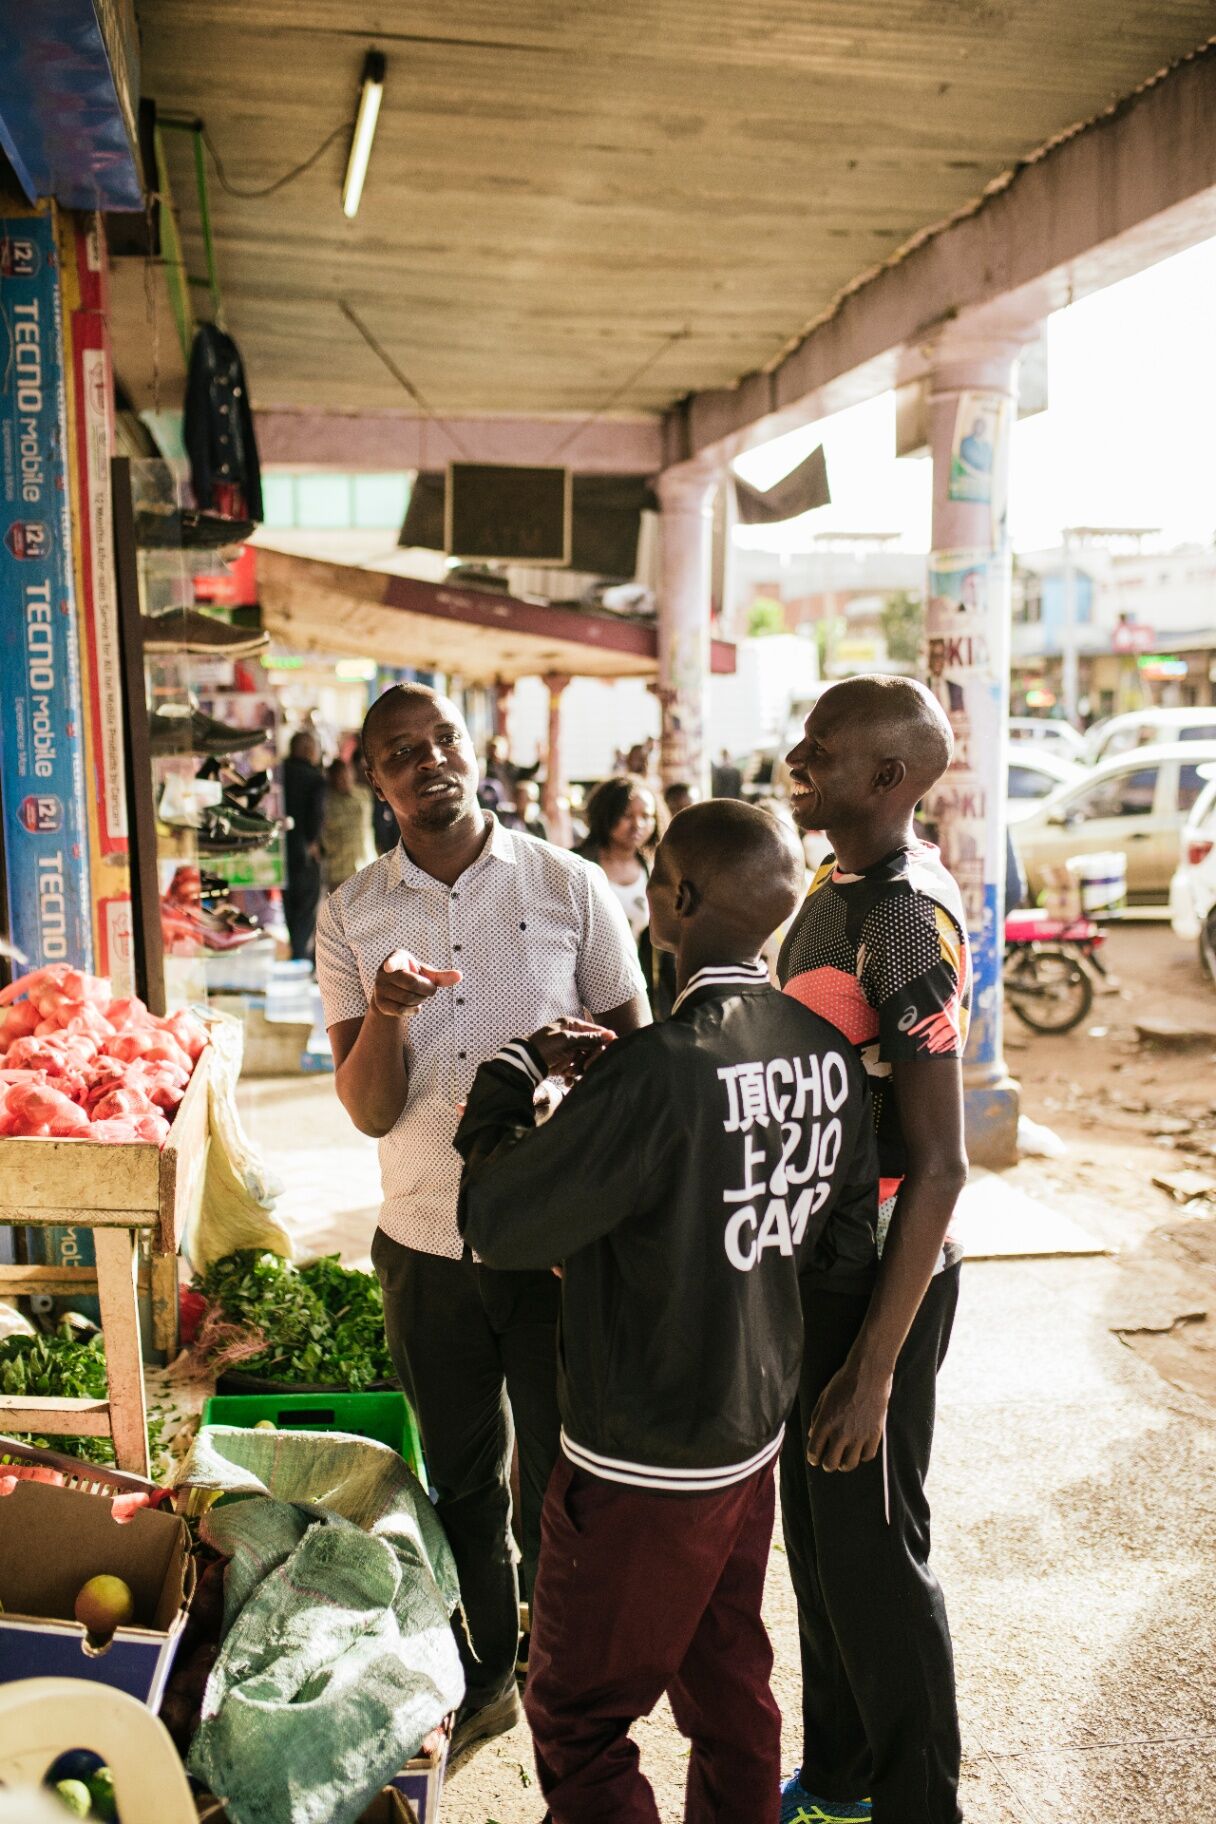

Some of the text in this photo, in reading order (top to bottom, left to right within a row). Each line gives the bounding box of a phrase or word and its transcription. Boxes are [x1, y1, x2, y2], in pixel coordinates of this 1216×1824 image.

[13, 297, 43, 413] TECNO
[25, 579, 55, 690] TECNO
[38, 850, 68, 959] TECNO
